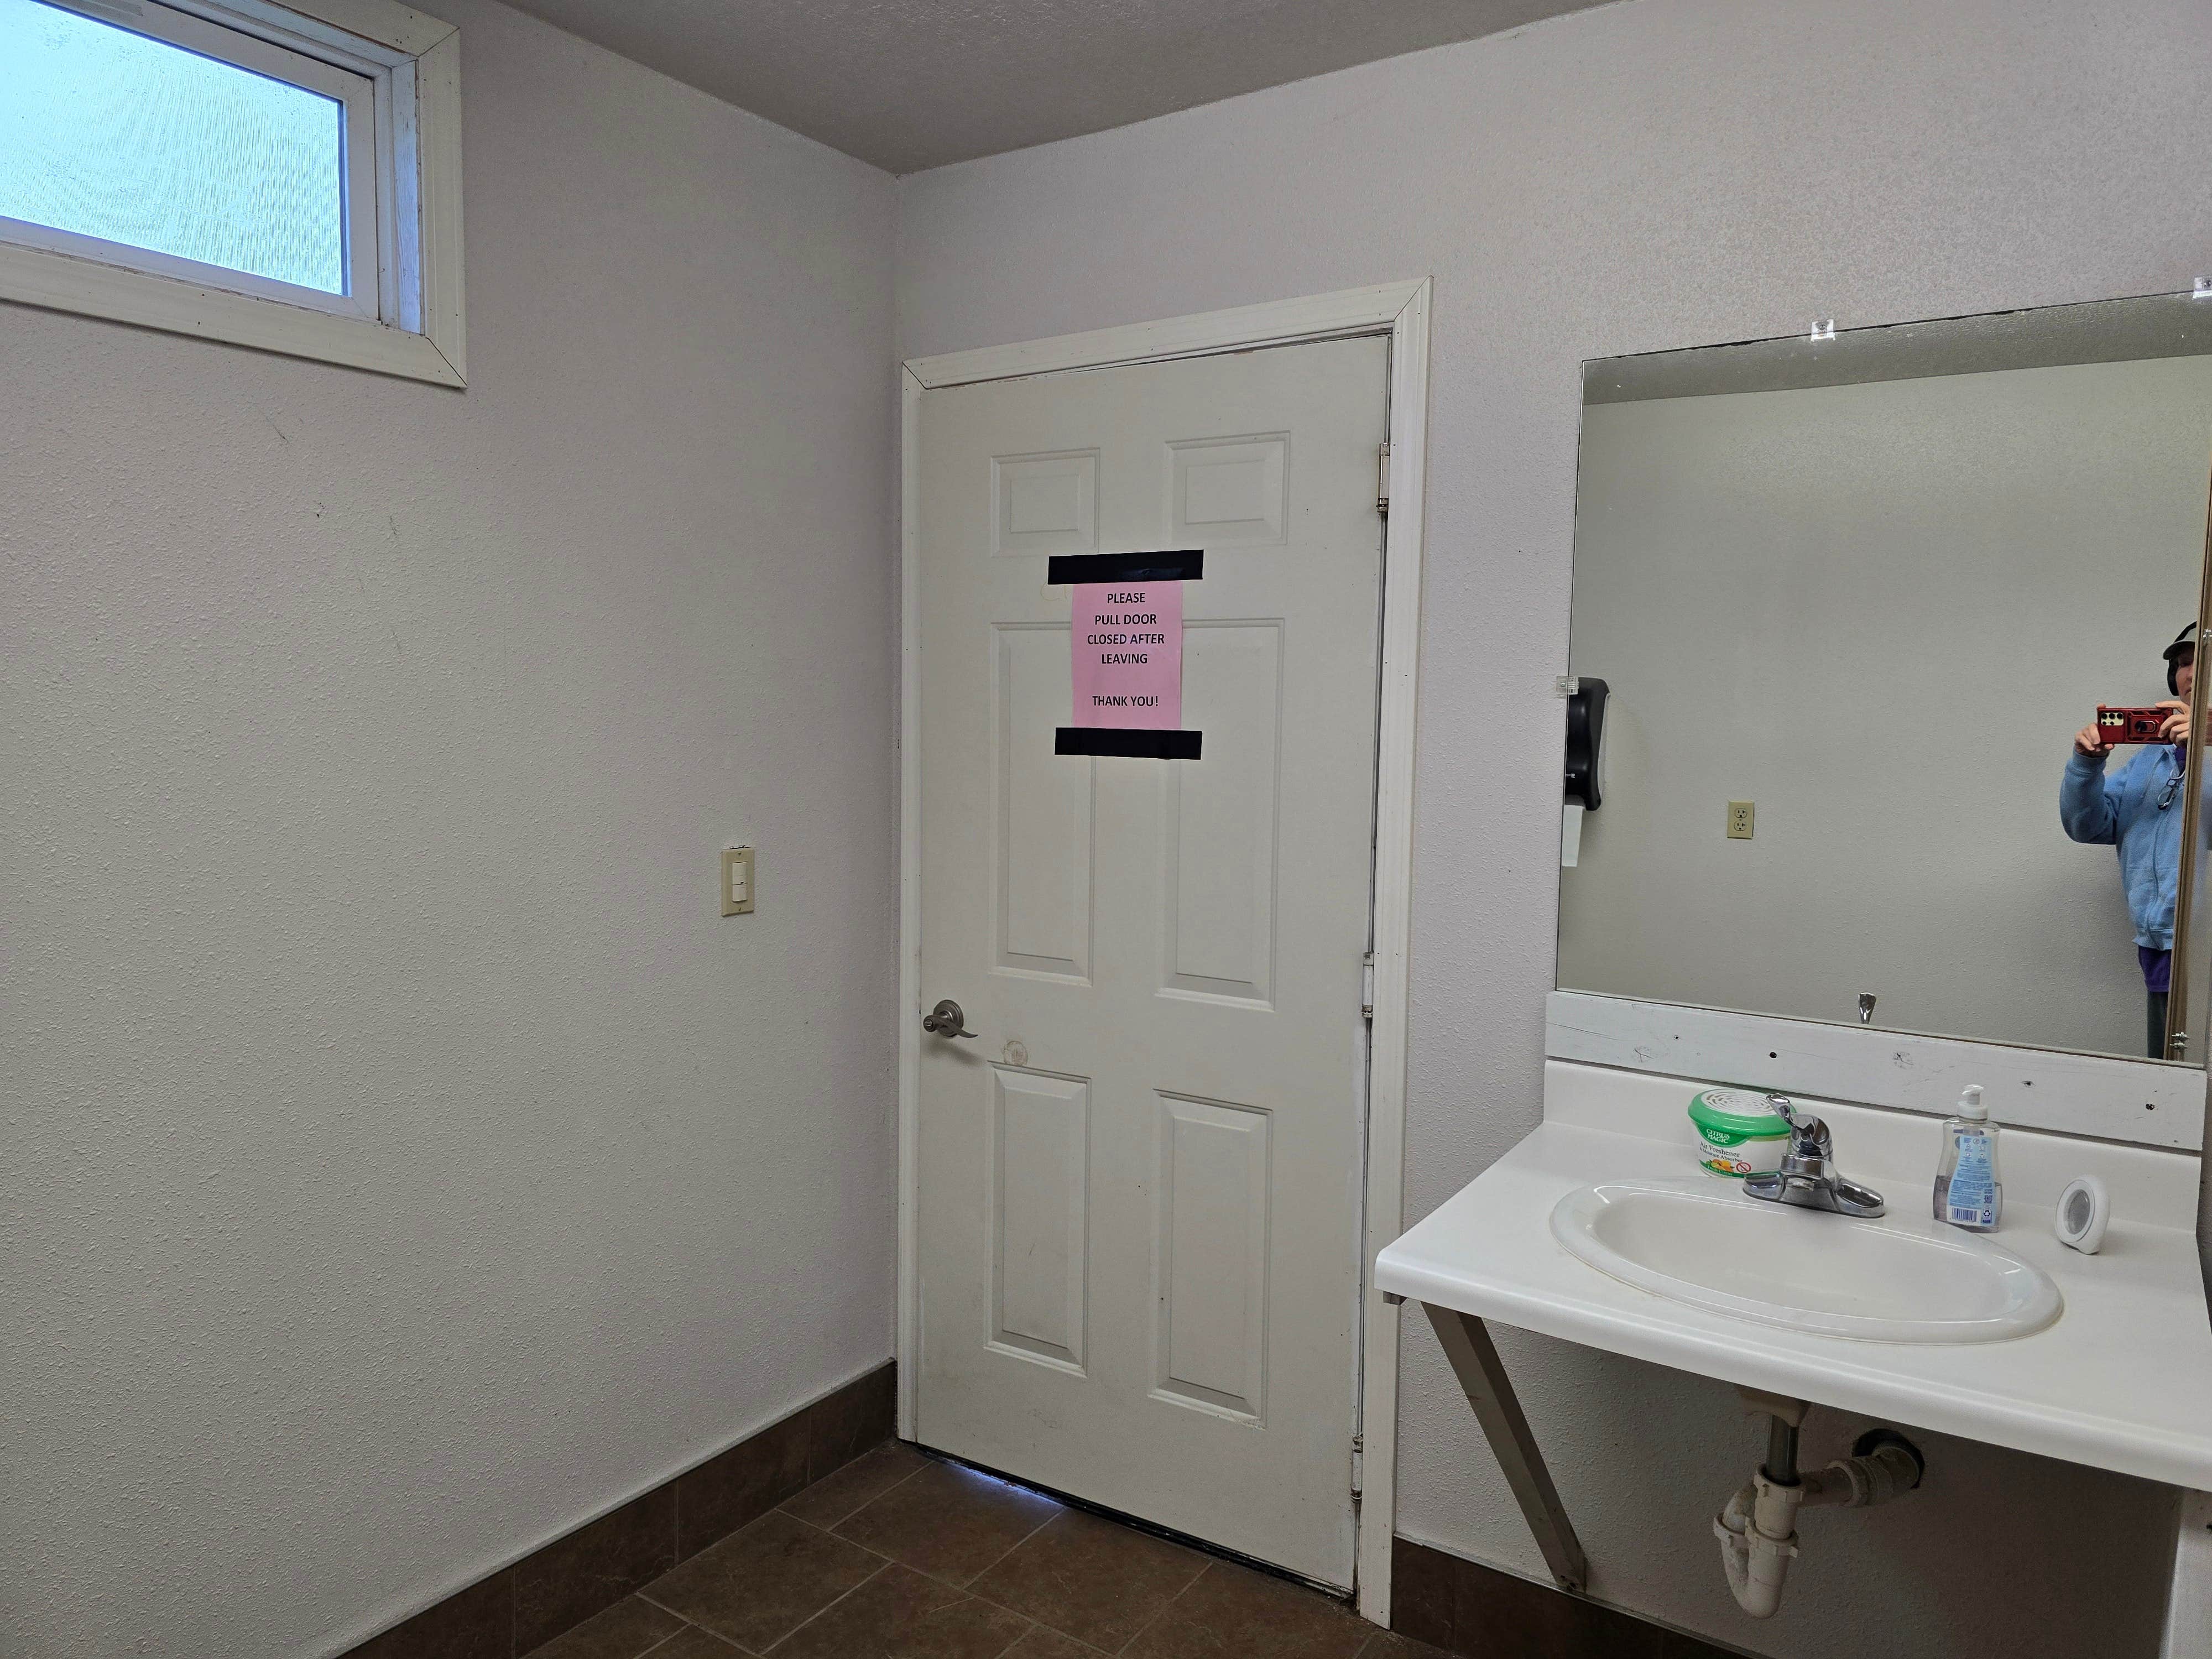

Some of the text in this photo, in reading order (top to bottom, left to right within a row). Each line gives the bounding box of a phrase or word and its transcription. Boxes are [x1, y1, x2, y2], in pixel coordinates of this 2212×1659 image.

[1107, 592, 1146, 604] PLEASE
[1094, 614, 1157, 625] PULL DOOR
[1087, 633, 1165, 645] CLOSED AFTER
[1102, 653, 1147, 664] LEAVING
[1092, 695, 1159, 707] THANK YOU!
[1706, 1129, 1730, 1139] CITRUS
[1707, 1134, 1728, 1143] MAGIC
[1709, 1145, 1741, 1157] Freshener
